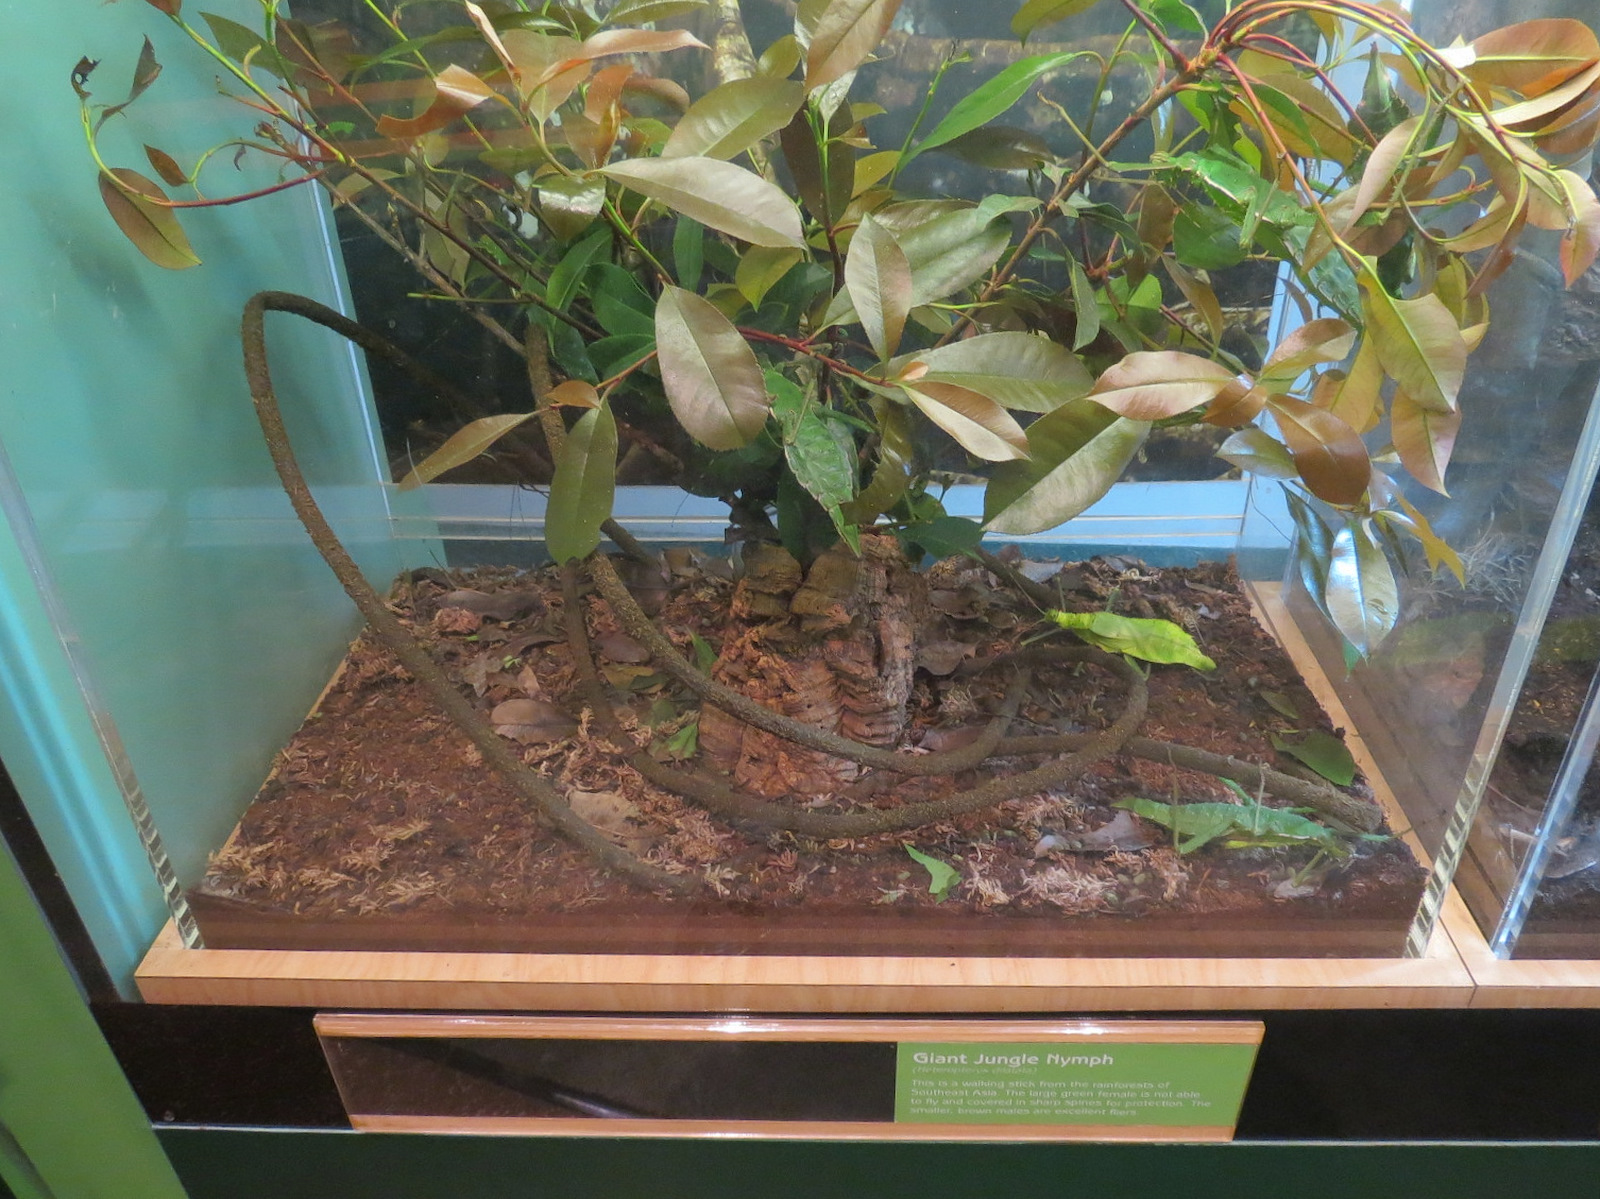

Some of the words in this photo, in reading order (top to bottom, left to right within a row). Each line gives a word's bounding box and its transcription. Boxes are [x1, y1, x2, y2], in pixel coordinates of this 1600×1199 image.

[913, 1052, 968, 1064] Giant
[974, 1053, 1039, 1068] Jungle
[1046, 1053, 1114, 1067] Nymph
[912, 1079, 935, 1087] This
[962, 1080, 1005, 1089] walking
[1008, 1080, 1035, 1088] stick
[1039, 1080, 1066, 1088] from
[1092, 1081, 1154, 1089] rainforests
[1157, 1081, 1170, 1089] of
[911, 1088, 968, 1096] Southeast
[1029, 1089, 1057, 1098] large
[1097, 1090, 1137, 1098] female
[926, 1098, 939, 1106] fly
[967, 1098, 1012, 1106] covered
[1030, 1099, 1061, 1107] sharp
